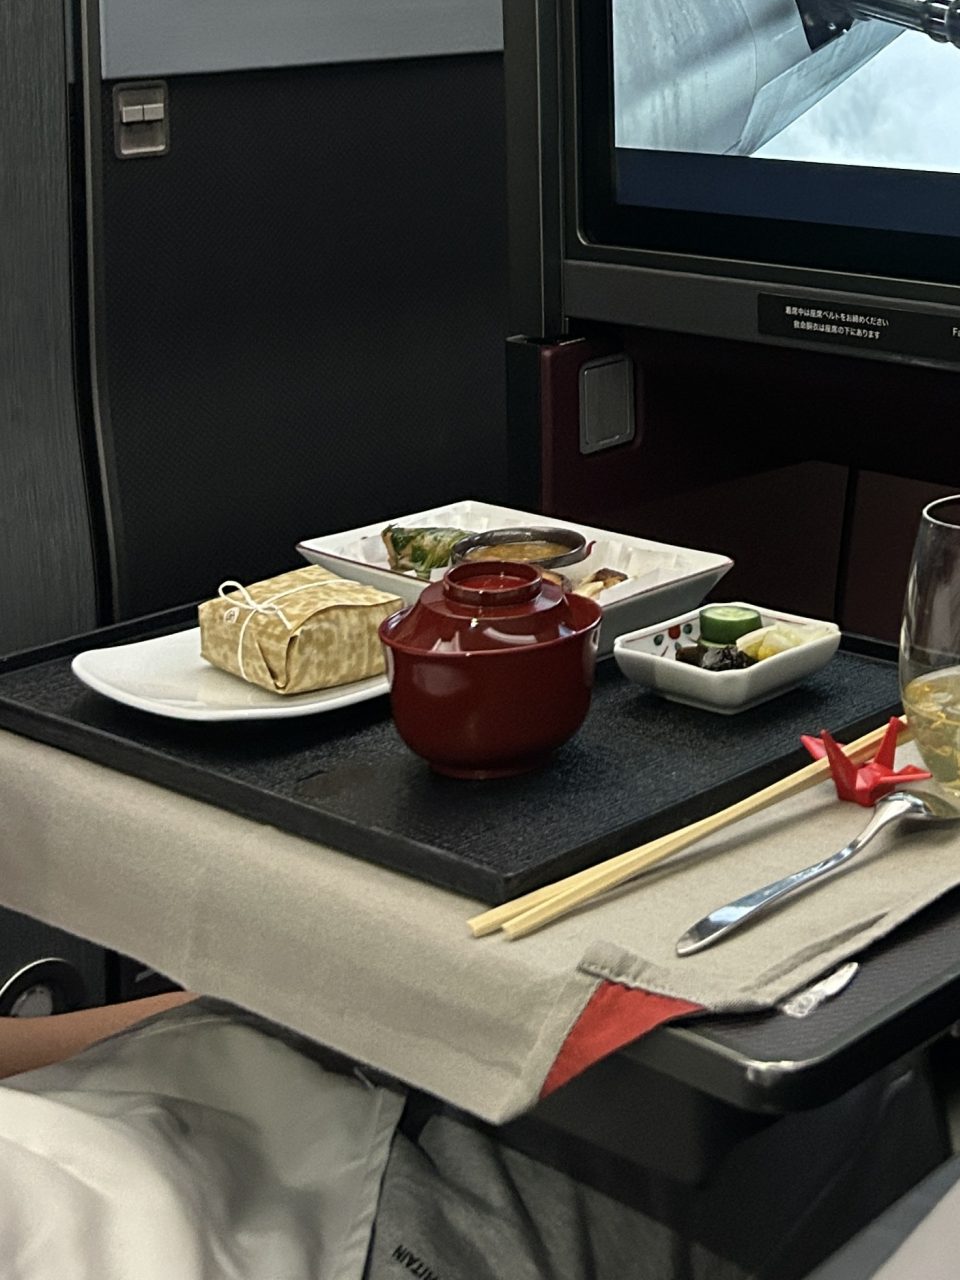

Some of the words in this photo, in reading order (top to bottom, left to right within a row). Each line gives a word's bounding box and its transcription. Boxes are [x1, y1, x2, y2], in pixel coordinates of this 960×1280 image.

[785, 306, 889, 326] 着席中は座席ベルトをお締めください
[793, 320, 881, 340] 救命胴衣は座席の下にあります
